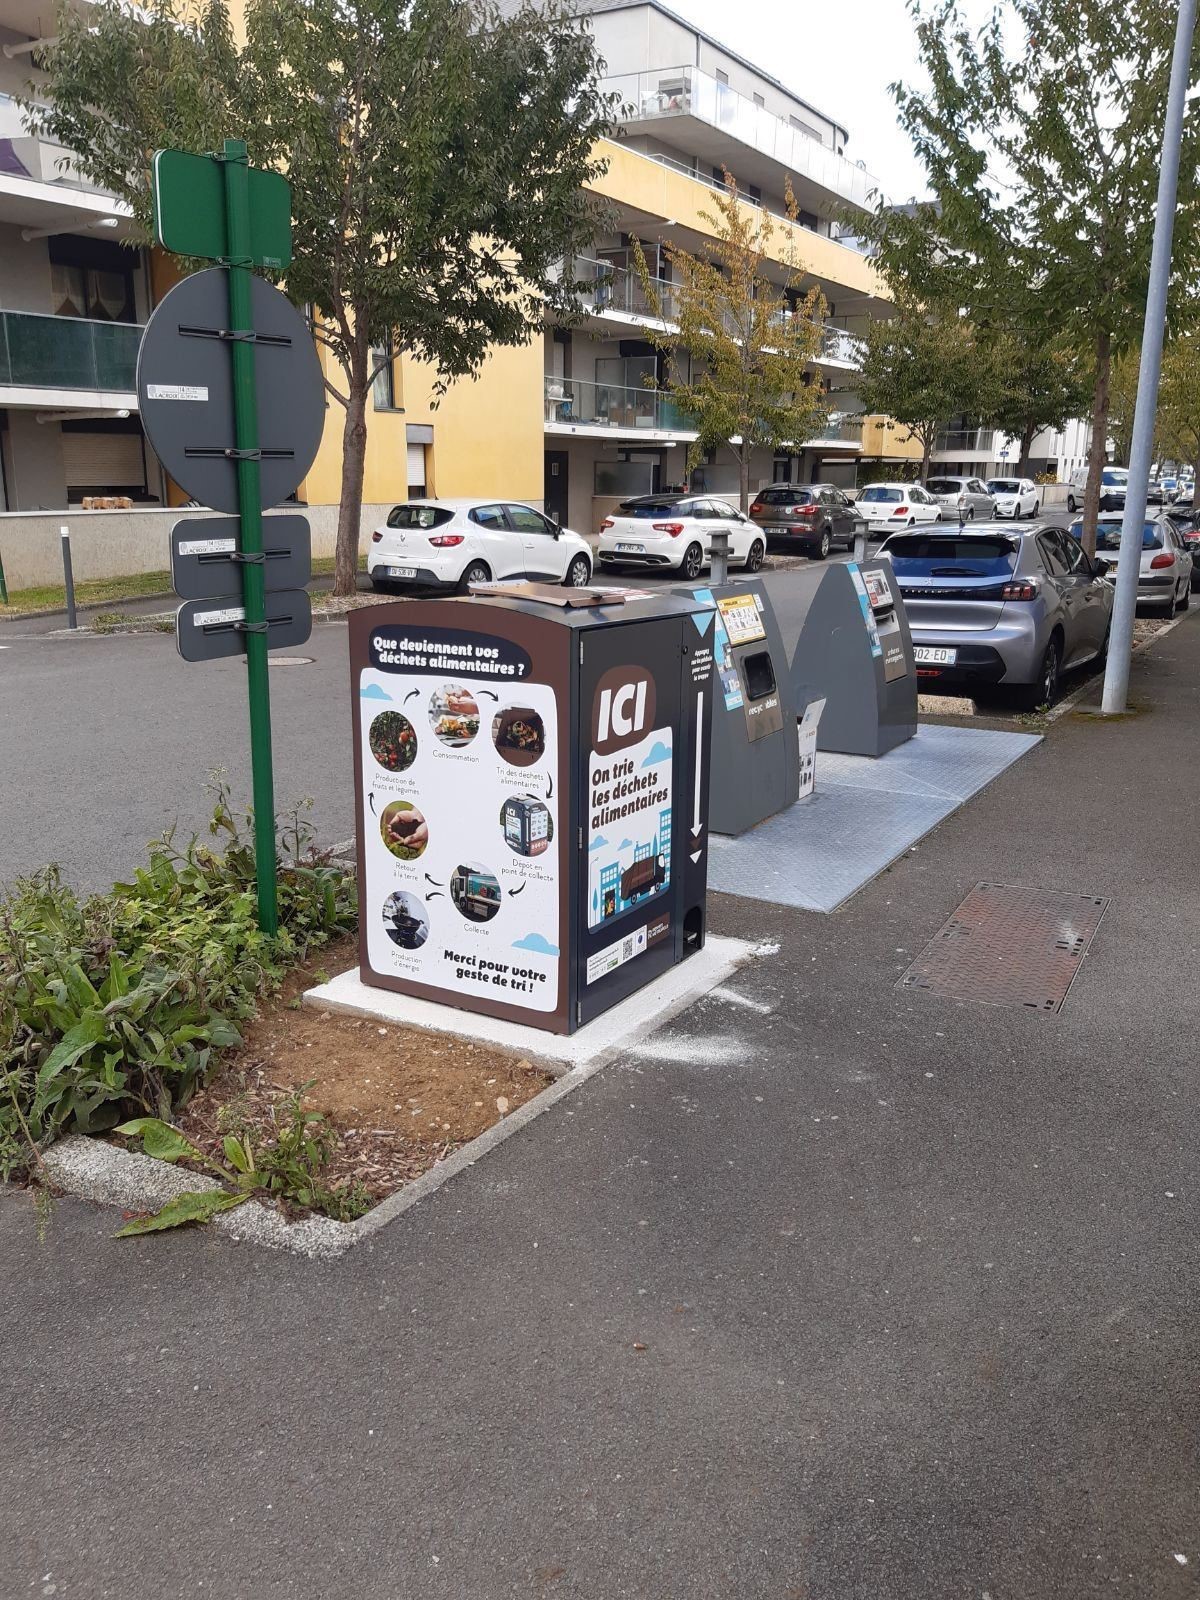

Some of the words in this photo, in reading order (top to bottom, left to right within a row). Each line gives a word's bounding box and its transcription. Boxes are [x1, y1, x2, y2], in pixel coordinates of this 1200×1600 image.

[374, 636, 397, 651] Que
[400, 638, 472, 656] deviennent
[475, 647, 499, 659] vos
[379, 650, 426, 667] déchets
[429, 656, 515, 675] alimentaires
[518, 664, 524, 676] ?
[597, 680, 647, 742] ICI
[433, 749, 479, 763] Consommation
[376, 773, 407, 785] Production
[519, 770, 544, 780] déchets
[592, 769, 610, 786] On
[613, 758, 634, 779] trie
[372, 781, 387, 790] fruits
[500, 777, 539, 789] alimentaires
[592, 790, 610, 808] les
[613, 772, 658, 800] déchets
[592, 788, 668, 829] alimentaires
[396, 862, 416, 871] Retour
[529, 872, 554, 881] collecte
[464, 924, 489, 935] Collecte
[392, 951, 422, 964] Production
[444, 950, 476, 966] Merci
[478, 960, 509, 973] pour
[512, 967, 546, 982] votre
[456, 968, 489, 982] geste
[492, 974, 507, 986] de
[511, 979, 526, 992] tri
[529, 983, 533, 993] !
